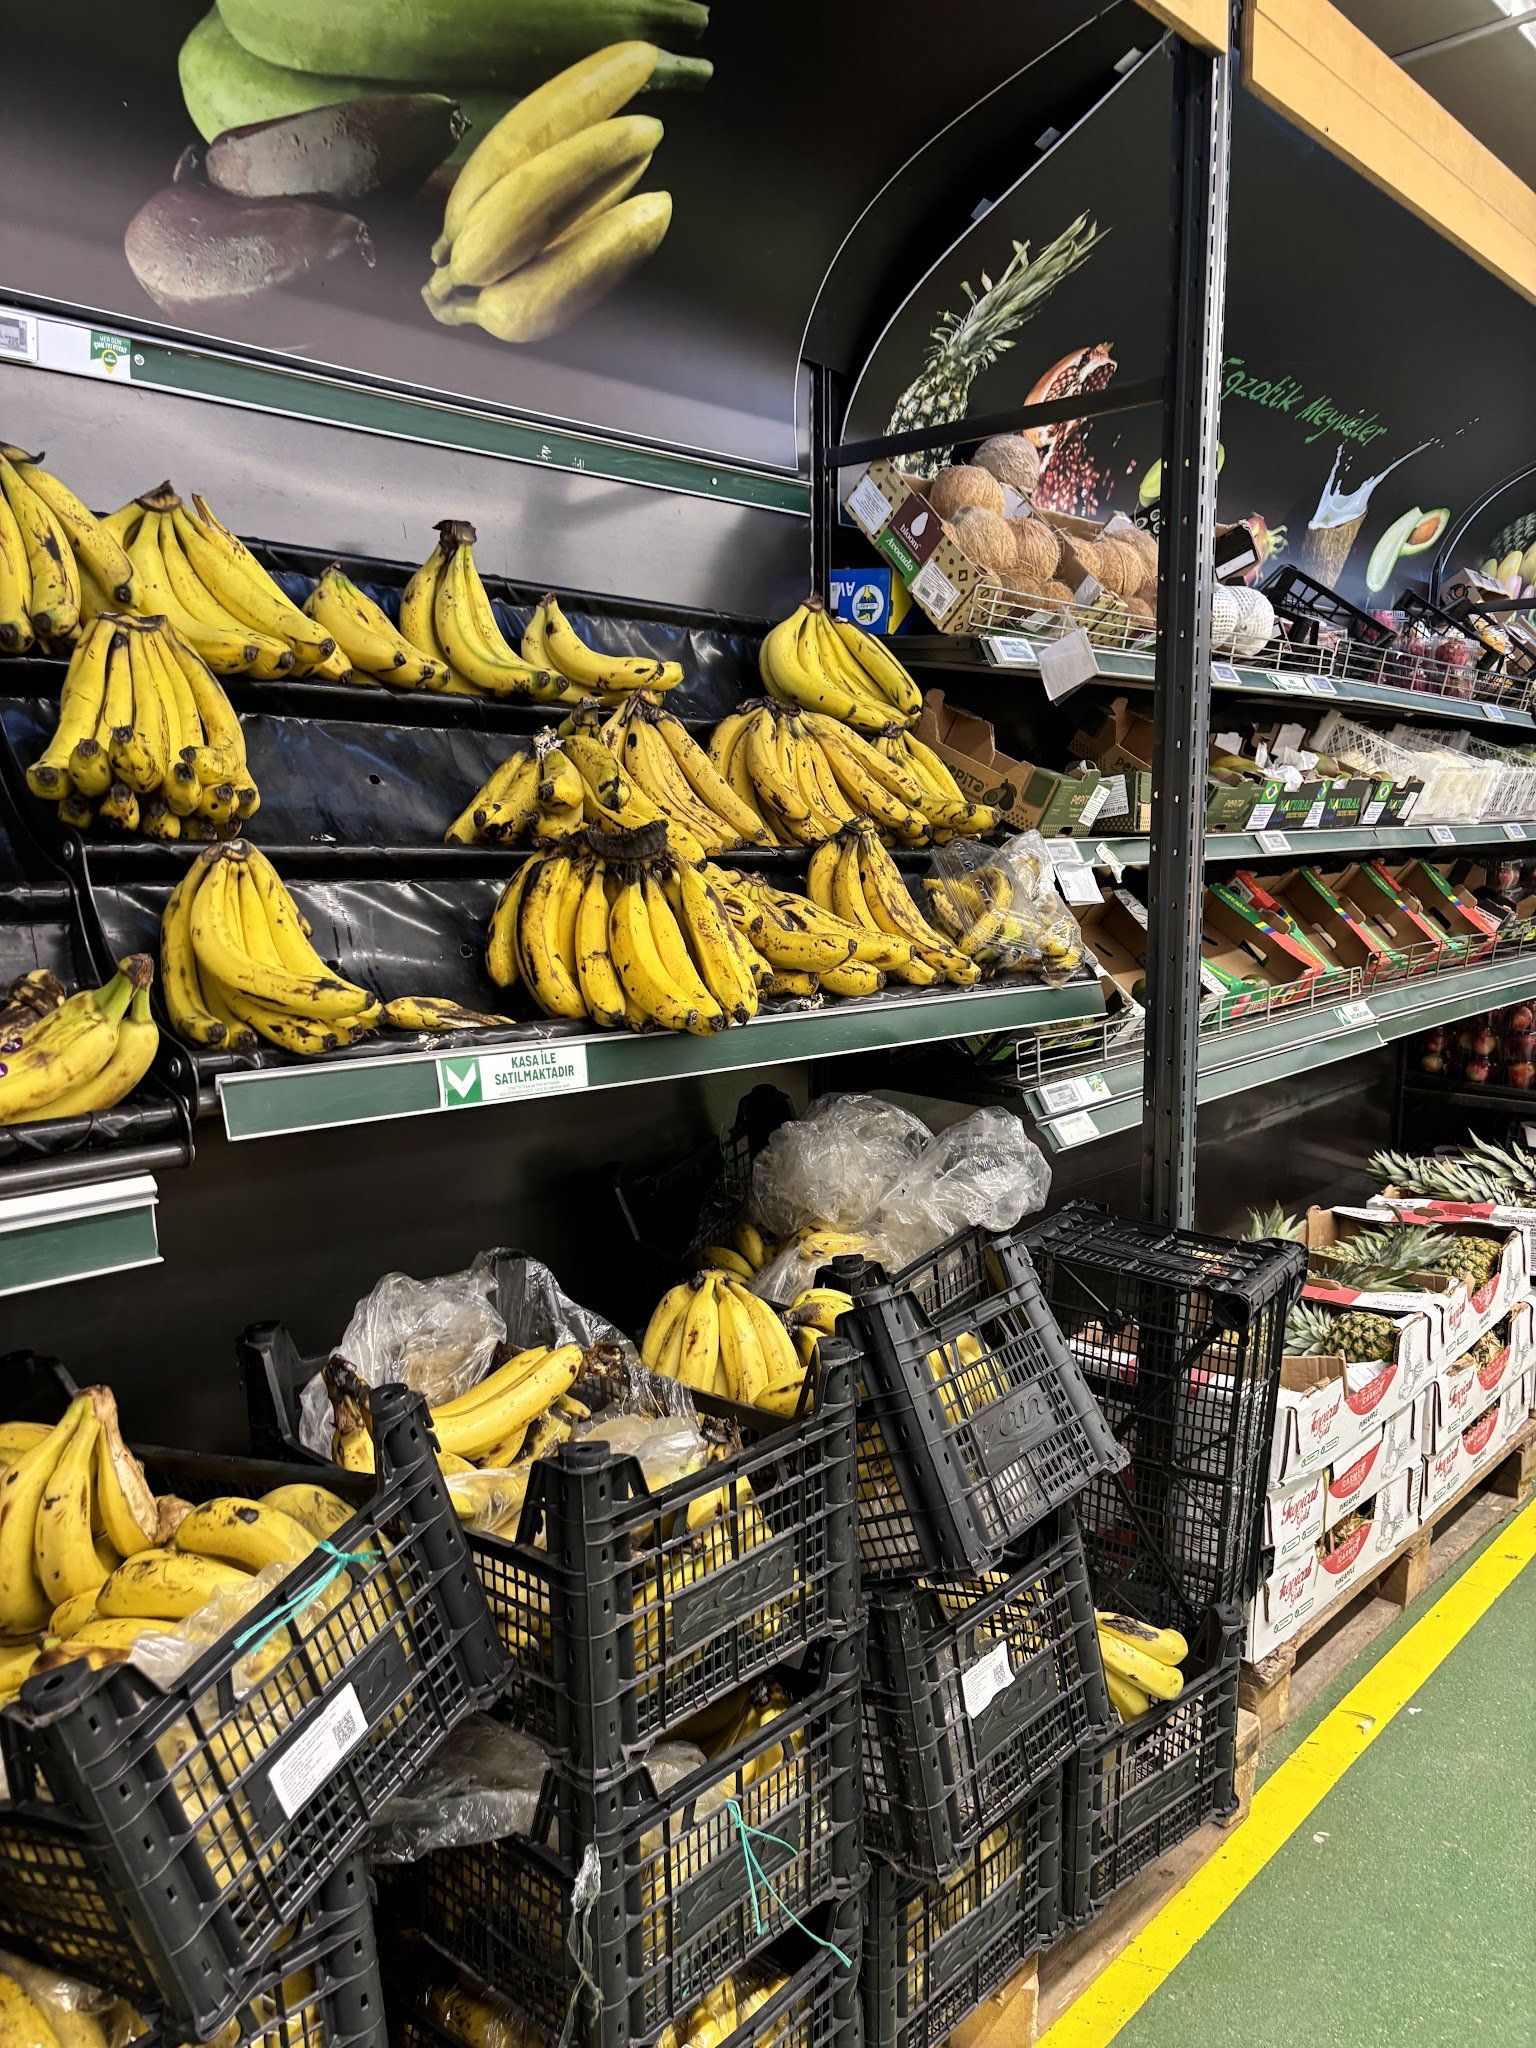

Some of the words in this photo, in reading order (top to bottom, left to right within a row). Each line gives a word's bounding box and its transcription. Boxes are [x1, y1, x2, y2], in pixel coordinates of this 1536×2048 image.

[1295, 395, 1388, 446] Meyveler
[899, 523, 920, 550] bloom
[885, 537, 914, 572] Avocado
[494, 1065, 575, 1086] SATILMAKTADIR
[511, 1054, 540, 1069] KASA
[540, 1050, 557, 1065] İLE
[1281, 1478, 1320, 1526] Tropical
[1279, 1556, 1313, 1602] Tropical
